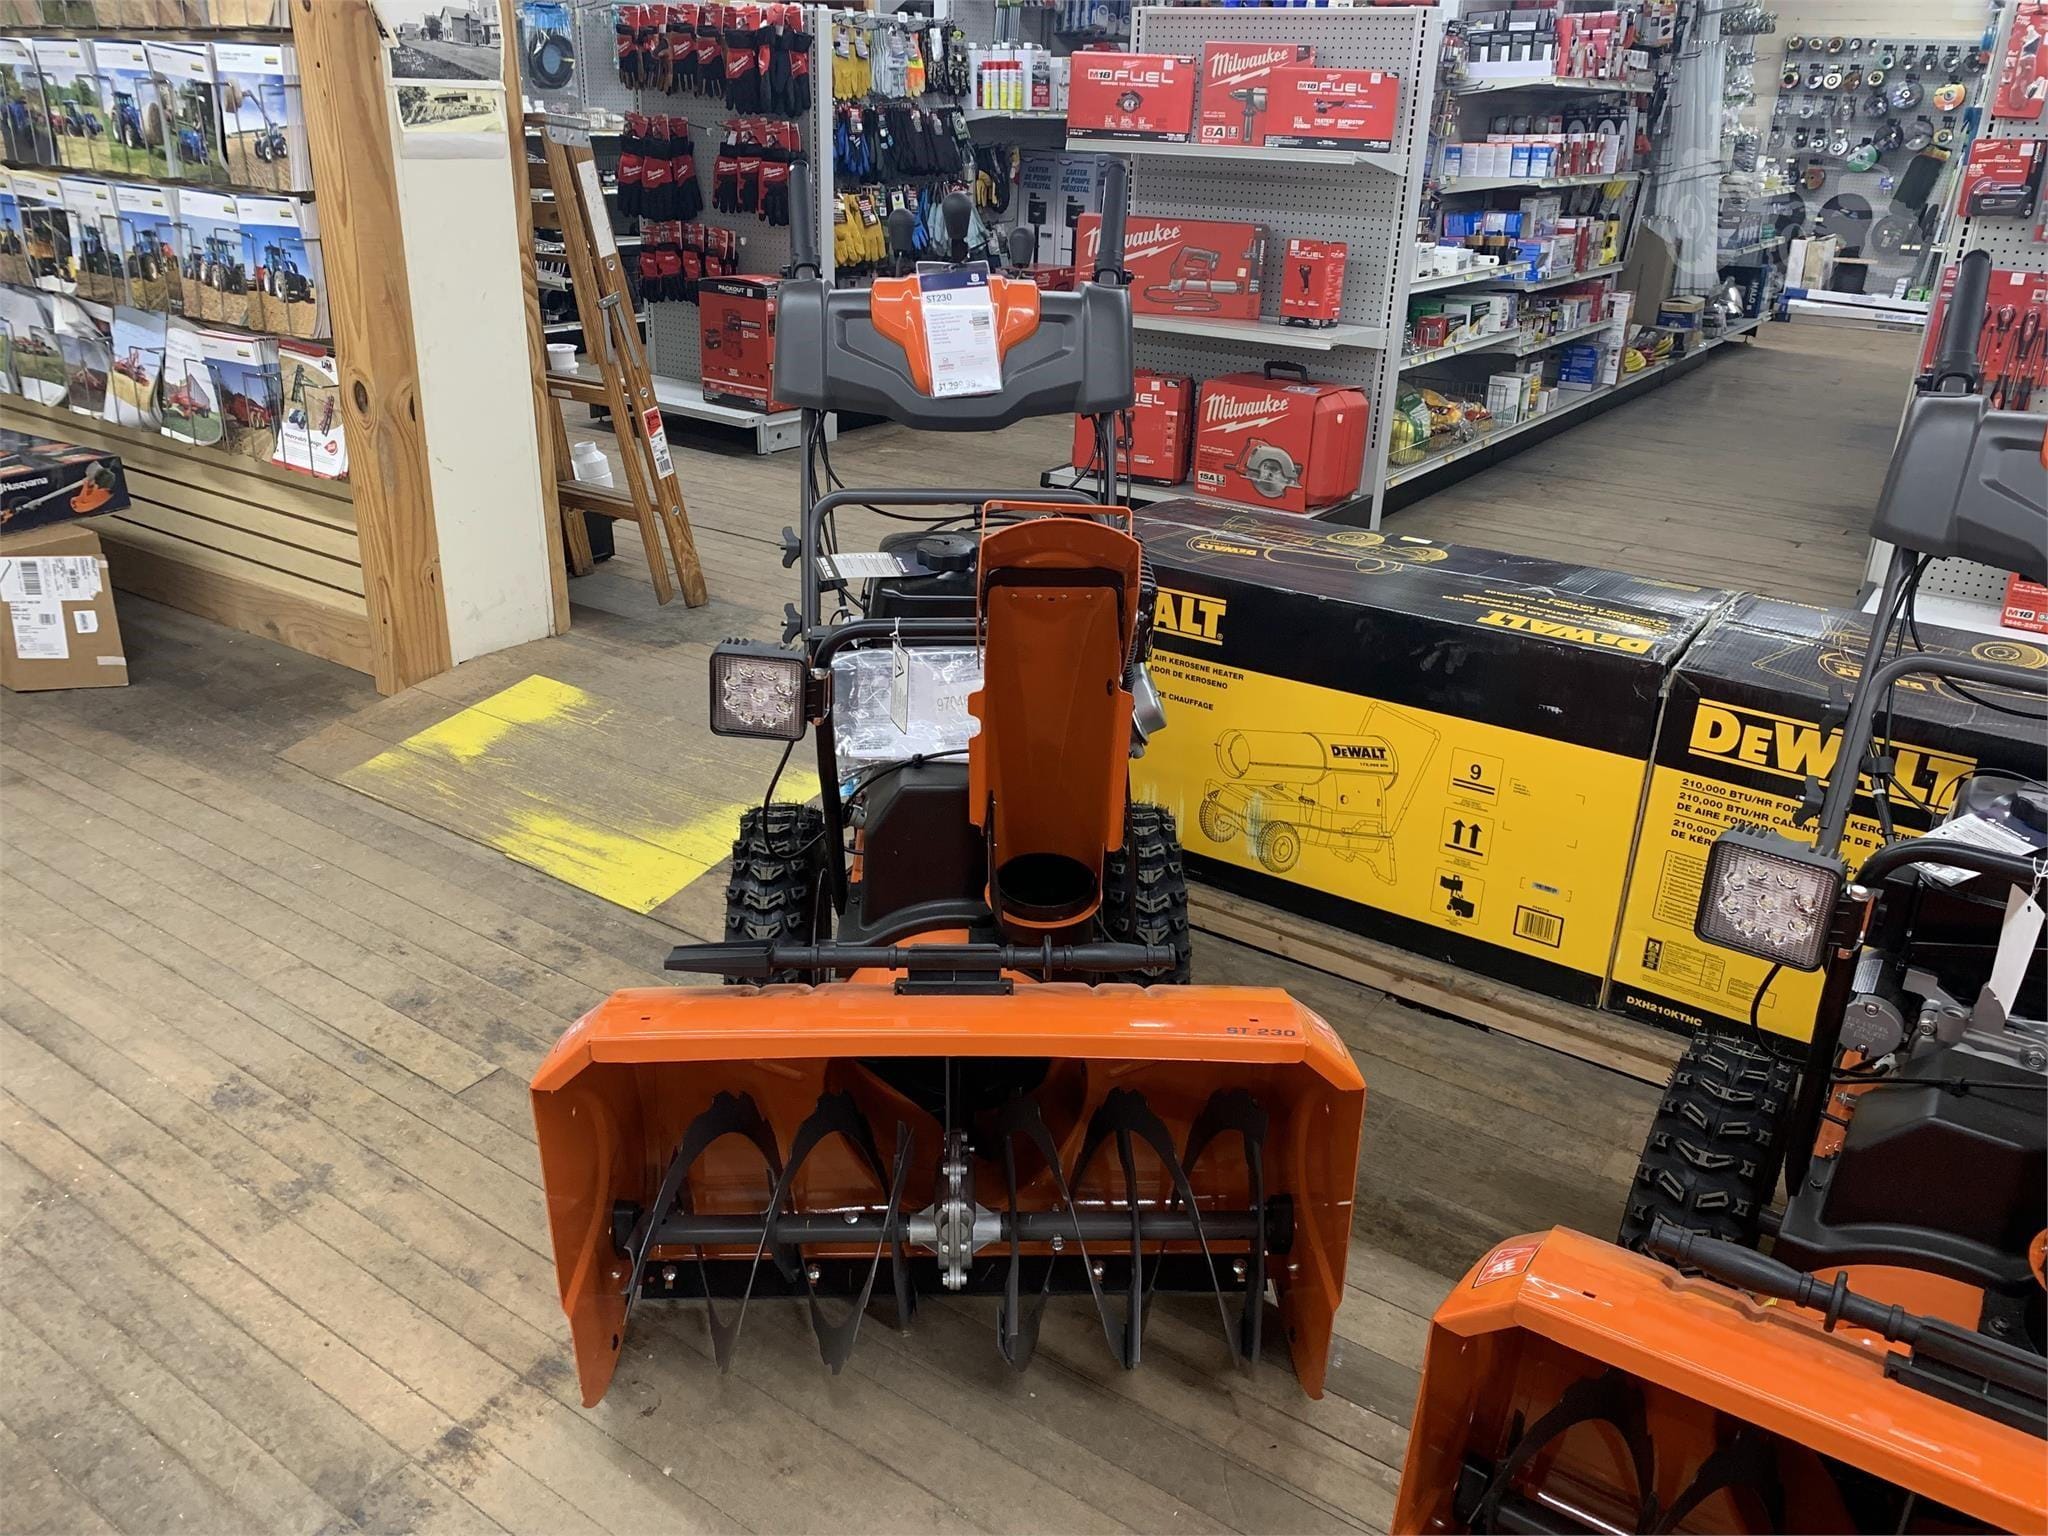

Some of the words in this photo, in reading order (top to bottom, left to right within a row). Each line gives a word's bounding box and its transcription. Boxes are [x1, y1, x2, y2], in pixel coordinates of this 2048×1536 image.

[1208, 47, 1289, 78] Milwaukee
[1089, 71, 1111, 79] M18
[1114, 70, 1174, 84] FUEL
[1298, 82, 1317, 90] M18
[1319, 82, 1369, 93] FUEL
[1204, 127, 1224, 136] 8A
[718, 284, 745, 294] PACKOUT
[926, 293, 953, 303] ST230
[1135, 393, 1165, 405] EL
[1202, 393, 1289, 423] Milwaukee
[3, 477, 48, 491] Husqvarna
[1153, 592, 1226, 640] ALT
[2008, 609, 2033, 619] M18
[1476, 609, 1656, 655] DEWALT
[1154, 654, 1167, 662] AIR
[1169, 657, 1211, 673] KEROSENE
[1212, 668, 1245, 681] HEATER
[1172, 671, 1183, 679] DE
[1185, 673, 1228, 690] KEROSENO
[1168, 693, 1214, 711] CHAUFFAGE
[1330, 745, 1386, 760] DEWALT
[1688, 703, 1975, 812] DEWLT
[1469, 764, 1482, 780] 9
[1682, 778, 1726, 795] 210,000
[1729, 789, 1773, 808] BTU/HR
[1677, 802, 1692, 812] DE
[1694, 807, 1720, 820] AIRE
[1679, 792, 1723, 809] 210,000
[1726, 803, 1769, 822] BTU/HR
[1854, 836, 1872, 848] DE
[1671, 829, 1685, 839] DE
[1673, 819, 1717, 837] 210,000
[1626, 995, 1703, 1027] DXH210KTHC
[1226, 1027, 1250, 1035] ST
[1257, 1028, 1296, 1037] 230
